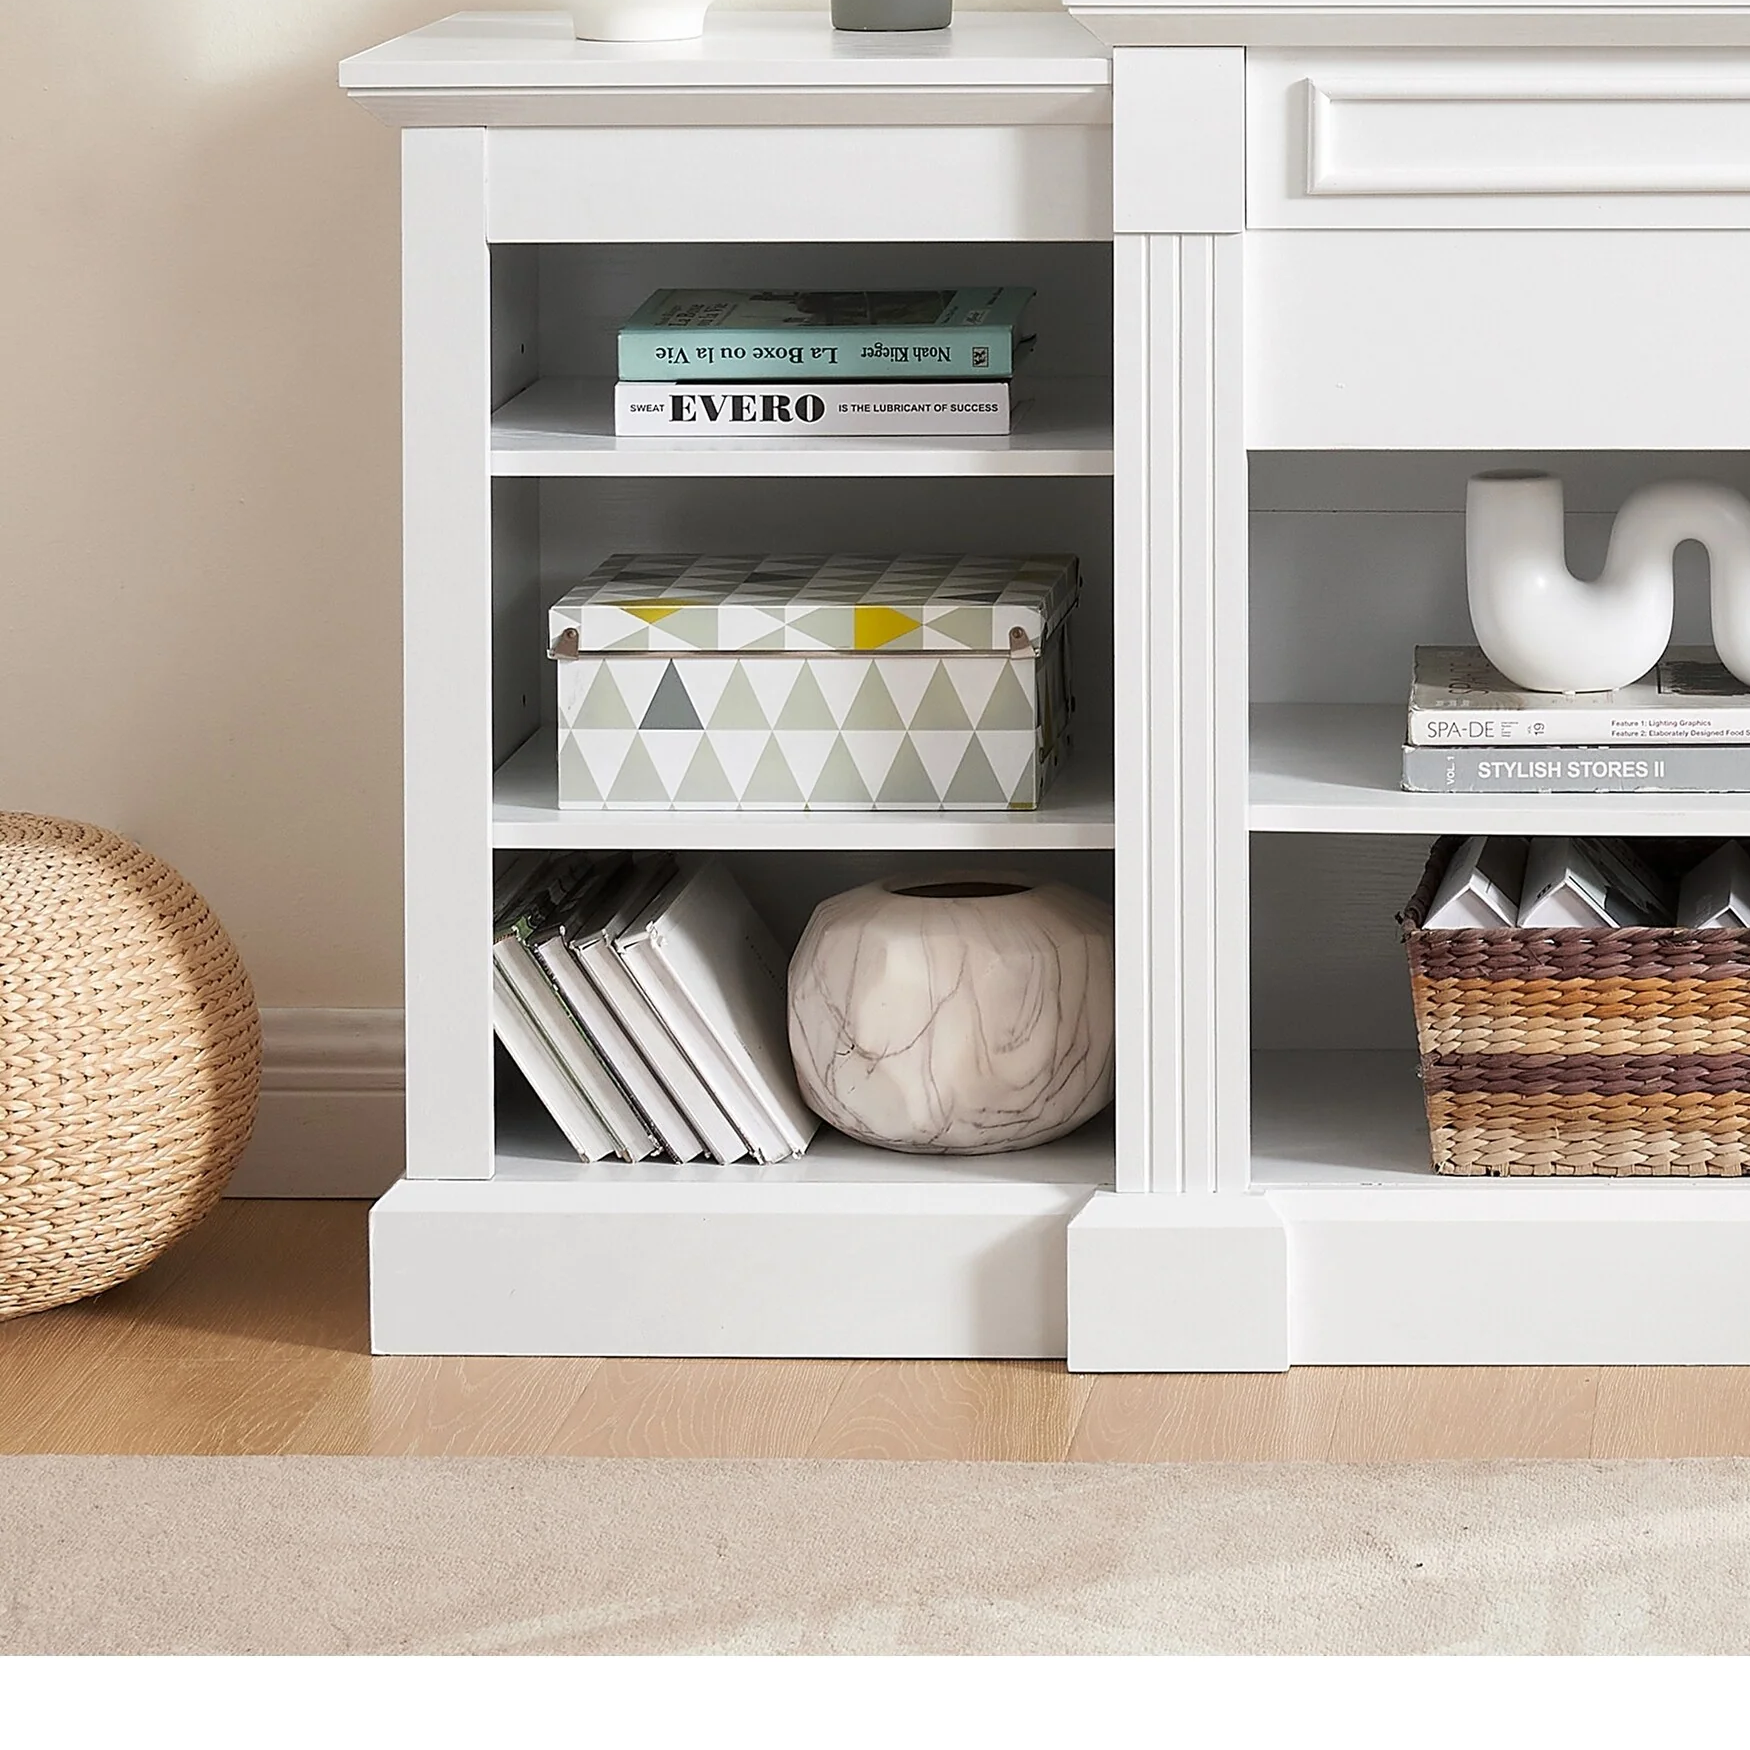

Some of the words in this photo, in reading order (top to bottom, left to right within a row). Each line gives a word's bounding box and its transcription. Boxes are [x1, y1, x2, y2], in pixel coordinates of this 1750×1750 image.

[655, 346, 691, 364] Vie
[696, 347, 714, 364] la
[721, 346, 746, 359] ou
[753, 346, 805, 364] Boxe
[811, 347, 838, 364] La
[861, 341, 910, 362] Klieger
[913, 346, 952, 362] Noah
[630, 404, 665, 413] SWEAT
[669, 394, 826, 423] EVERO
[838, 404, 848, 412] IS
[851, 404, 871, 412] THE
[873, 403, 932, 412] LUBRICANT
[934, 403, 948, 412] OF
[950, 403, 999, 412] SUCCESS
[1427, 721, 1495, 738] SPA-DE
[1533, 722, 1545, 736] 19
[1649, 719, 1678, 729] Lighting
[1679, 719, 1712, 729] Graphics
[1611, 729, 1639, 737] Feature
[1649, 729, 1689, 738] Elaborately
[1690, 729, 1724, 738] Designed
[1726, 729, 1744, 737] Food
[1478, 761, 1562, 778] STYLISH
[1567, 761, 1649, 778] STORES
[1654, 761, 1665, 778] II
